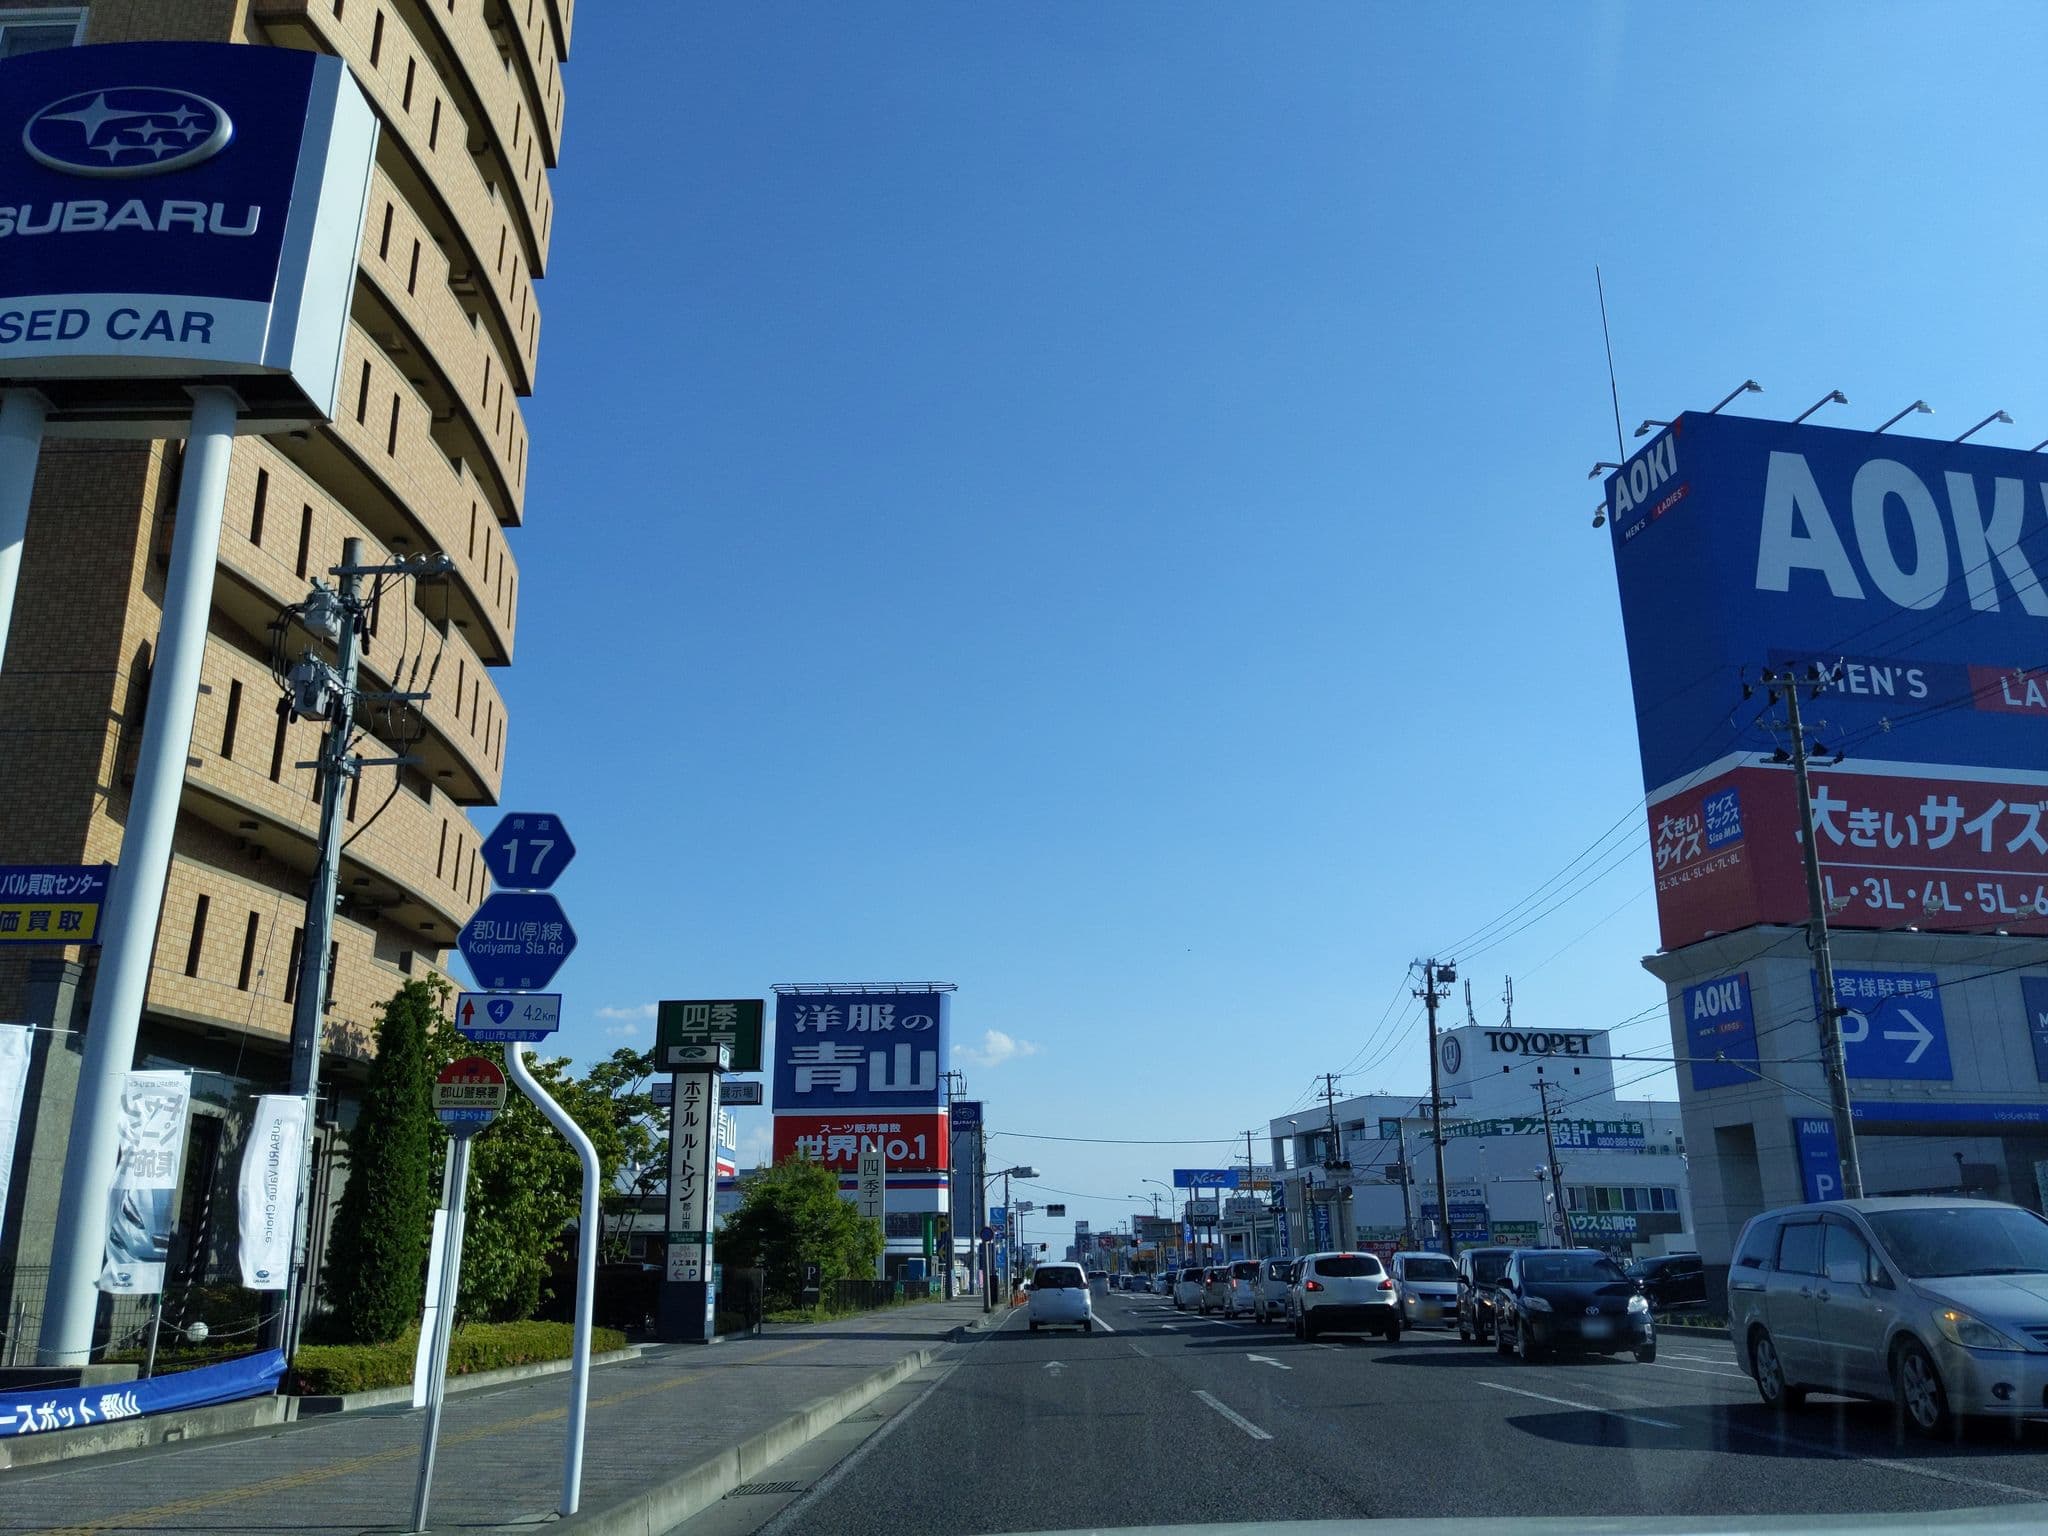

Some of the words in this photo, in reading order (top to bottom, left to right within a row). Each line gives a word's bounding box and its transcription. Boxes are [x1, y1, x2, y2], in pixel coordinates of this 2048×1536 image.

[105, 308, 215, 344] CAR
[1615, 432, 1678, 521] AOKI
[1625, 518, 1645, 541] MEN'S
[1755, 450, 2048, 617] AOK
[1816, 661, 1928, 699] MEN'S
[2000, 676, 2048, 708] LA
[1658, 813, 1699, 845] 大きい
[1706, 808, 1739, 830] マックス
[1796, 786, 2048, 855] 大きいサイズ
[502, 838, 555, 874] 17
[1656, 829, 1703, 870] サイズ
[468, 941, 521, 956] Koriyama
[1694, 981, 1741, 1020] AOKI
[1832, 977, 1935, 999] 客様駐車場
[494, 1003, 505, 1018] 4
[682, 1004, 737, 1031] 四季
[794, 1003, 934, 1033] 洋服の
[1485, 1032, 1592, 1054] TOYOPET
[788, 1040, 937, 1093] 青山
[440, 1086, 498, 1098] 郡山警察署
[683, 1081, 701, 1127] ホテル
[820, 1123, 901, 1133] スーツ販売着数
[1595, 1121, 1641, 1134] 郡山支店
[1803, 1120, 1829, 1134] AOKI
[795, 1134, 926, 1161] 世界No.1
[680, 1134, 698, 1201] ルートイン
[1816, 1173, 1833, 1200] P
[682, 1202, 693, 1229] 郡山南
[688, 1268, 697, 1280] P
[807, 1267, 816, 1280] P
[99, 1390, 141, 1421] 郡山
